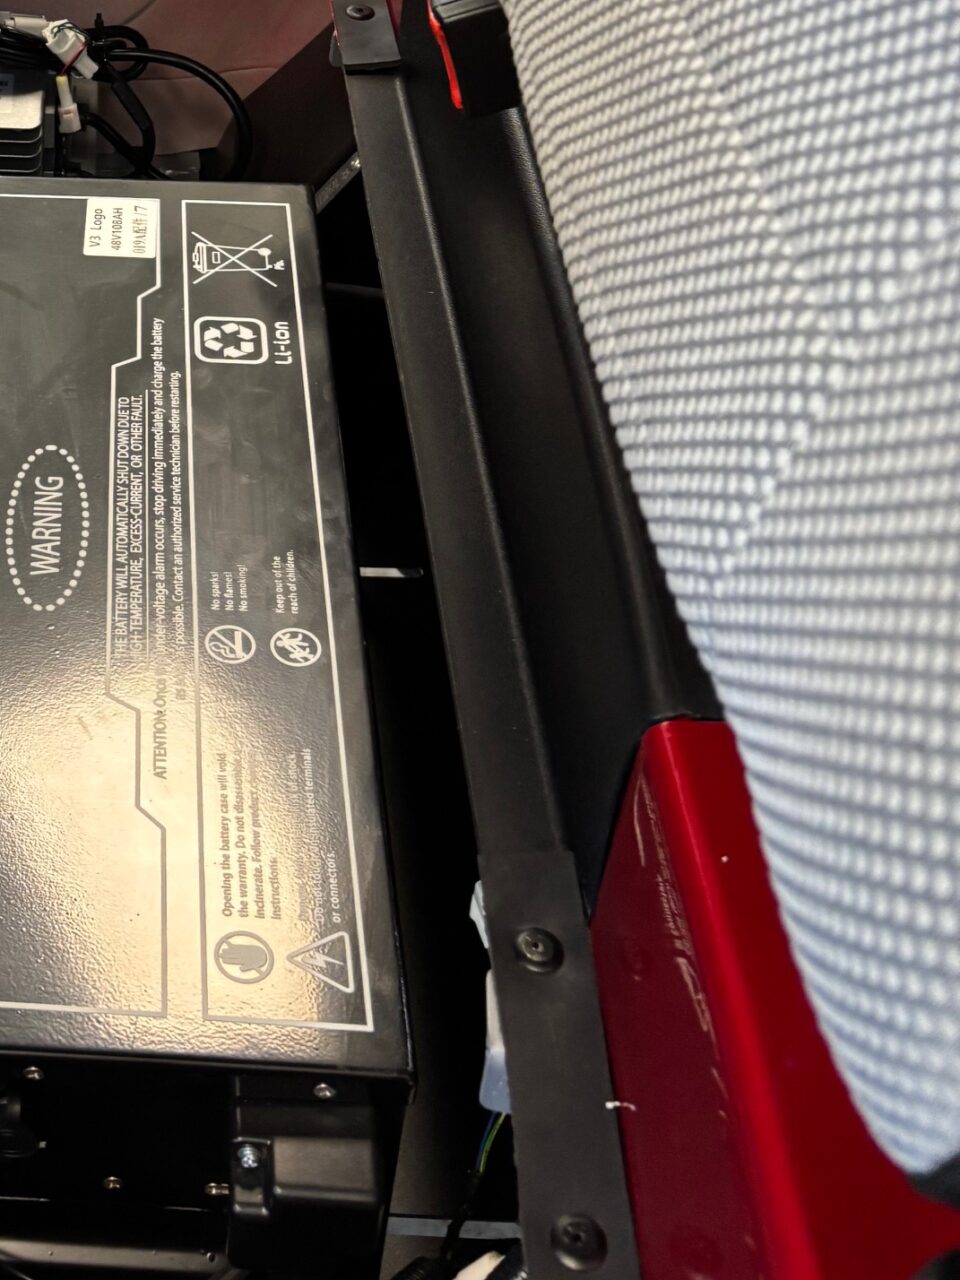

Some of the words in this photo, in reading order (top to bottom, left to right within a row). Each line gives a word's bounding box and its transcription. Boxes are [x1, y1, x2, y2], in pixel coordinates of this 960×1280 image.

[90, 208, 105, 231] Logo
[88, 235, 101, 247] V3
[150, 317, 165, 345] battery
[151, 346, 162, 360] the
[151, 361, 166, 388] charge
[118, 397, 130, 409] TO
[151, 390, 163, 406] and
[169, 371, 182, 408] restarting.
[118, 410, 130, 427] DUE
[131, 394, 144, 421] FAULT.
[169, 409, 181, 433] before
[117, 428, 130, 458] DOWN
[130, 421, 144, 451] OTHER
[150, 407, 166, 459] immediately
[131, 455, 143, 468] OR
[170, 435, 182, 475] technician
[117, 459, 129, 484] SHUT
[151, 461, 166, 493] driving
[170, 477, 182, 505] service
[130, 471, 144, 553] EXCESS-CURRENT,
[152, 495, 167, 516] stop
[29, 476, 64, 575] WARNING
[115, 486, 129, 562] AUTOMATICALLY
[152, 517, 166, 550] occurs,
[169, 507, 183, 553] authorized
[153, 552, 166, 580] alarm
[174, 553, 183, 565] an
[272, 556, 281, 568] the
[285, 549, 296, 581] children.
[115, 565, 129, 589] WILL
[172, 567, 184, 602] Contact
[210, 571, 221, 597] sparks!
[237, 565, 248, 599] smoking!
[273, 569, 282, 578] of
[274, 580, 283, 592] out
[288, 582, 297, 591] of
[115, 590, 129, 635] BATTERY
[211, 599, 220, 610] No
[224, 599, 233, 611] No
[238, 600, 248, 611] No
[275, 594, 285, 613] Keep
[288, 593, 299, 614] reach
[153, 582, 168, 655] under-voltage
[173, 604, 187, 644] possible.
[301, 748, 312, 790] terminals
[219, 793, 230, 814] case
[219, 816, 232, 851] battery
[234, 816, 245, 832] not
[235, 834, 246, 849] Do
[250, 829, 262, 862] Follow
[220, 853, 231, 870] the
[236, 851, 249, 898] warranty.
[252, 864, 264, 920] incinerate.
[326, 850, 341, 909] connectors.
[221, 873, 234, 917] Opening
[238, 900, 248, 918] the
[332, 911, 341, 923] or
